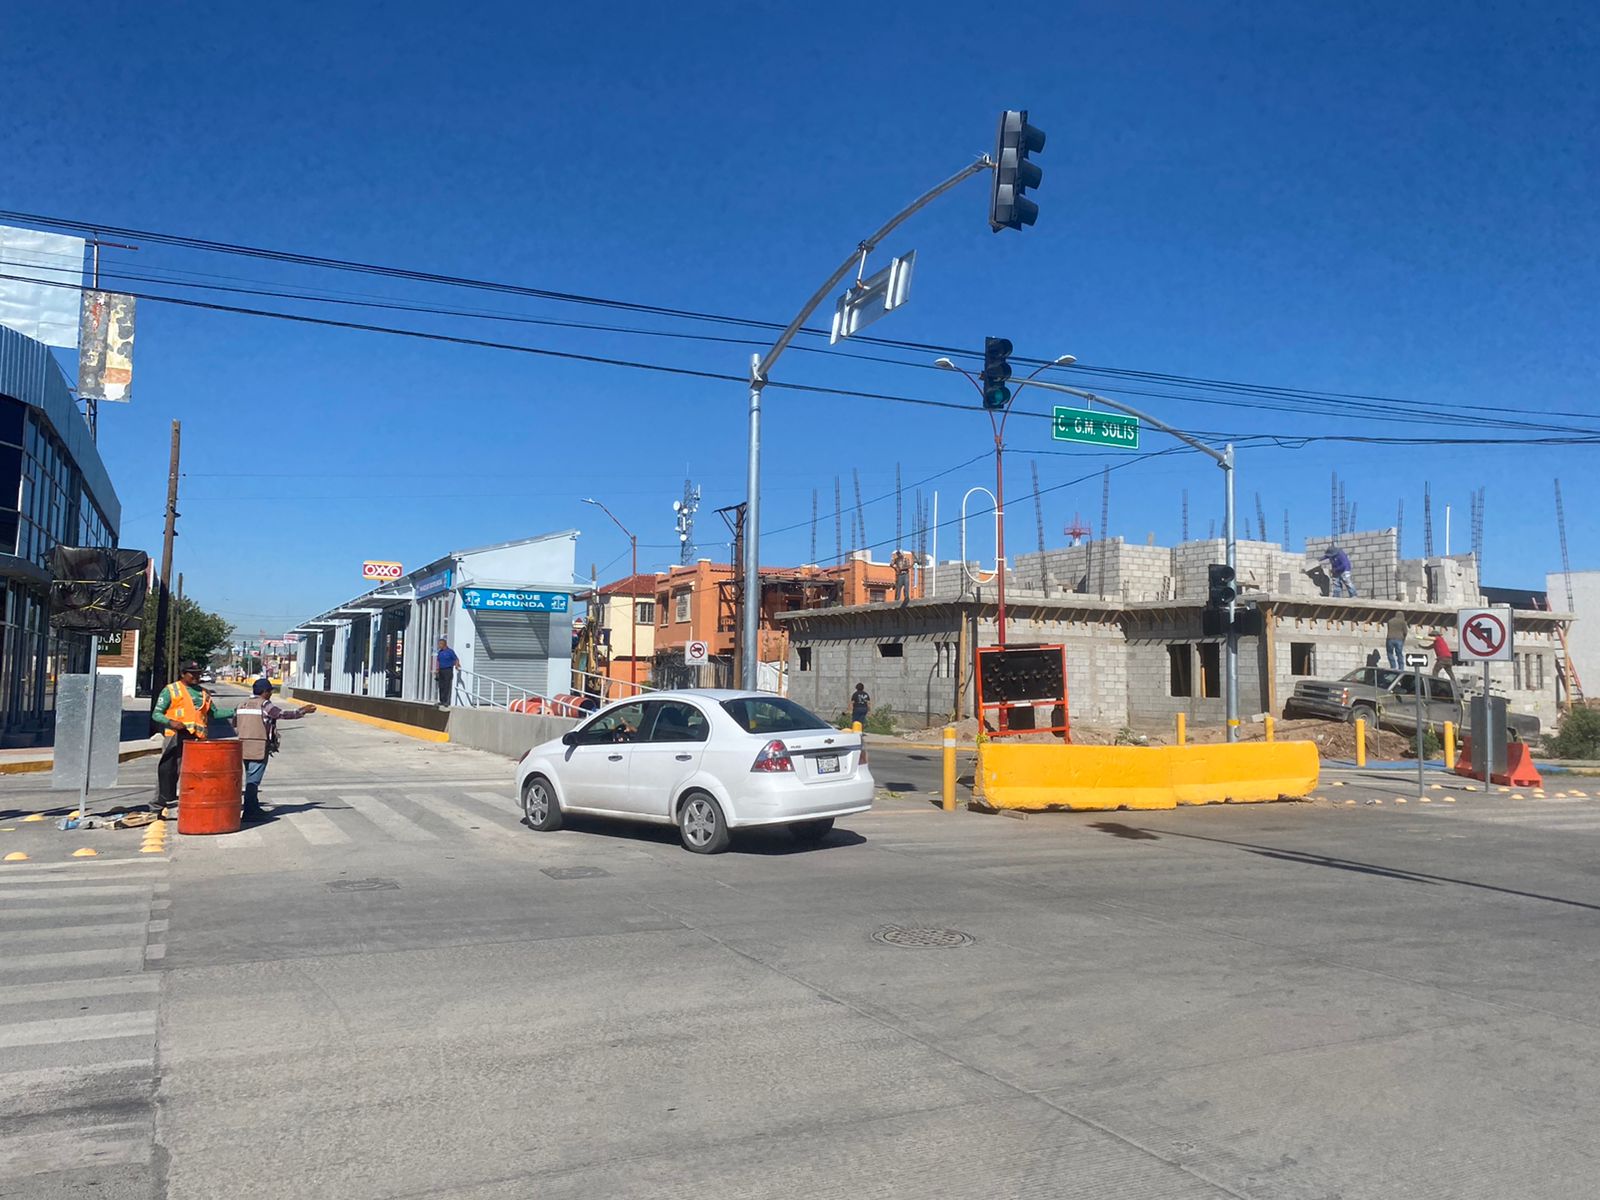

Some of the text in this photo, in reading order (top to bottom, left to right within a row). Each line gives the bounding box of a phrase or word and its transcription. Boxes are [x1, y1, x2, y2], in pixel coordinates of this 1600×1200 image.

[1058, 415, 1069, 431] C.
[364, 564, 401, 578] OXXO
[491, 592, 541, 600] PARQUE
[486, 600, 545, 608] BORUNDA
